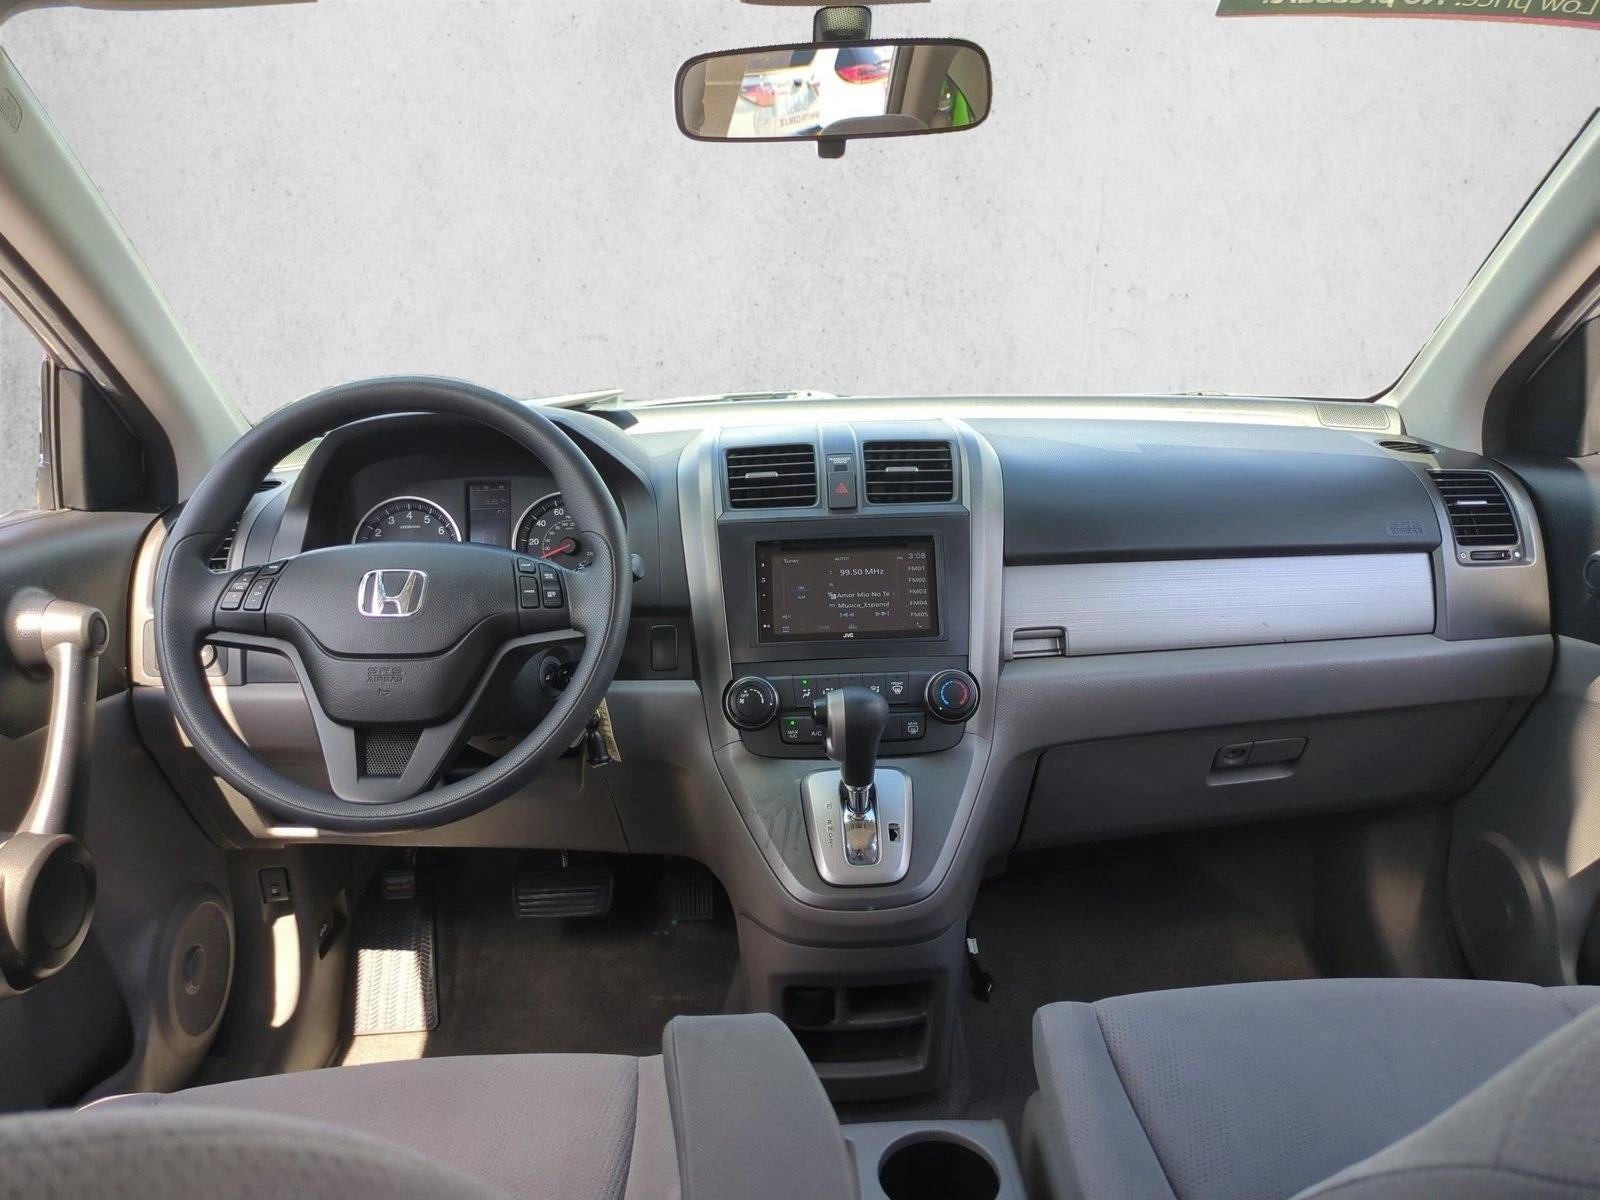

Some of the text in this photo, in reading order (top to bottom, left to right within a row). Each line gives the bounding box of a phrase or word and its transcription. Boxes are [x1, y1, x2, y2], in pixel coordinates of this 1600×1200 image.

[406, 511, 413, 520] 4
[553, 508, 564, 516] 60
[388, 516, 395, 525] 3
[424, 515, 431, 524] 5
[536, 519, 547, 527] 40
[374, 528, 382, 537] 2
[438, 526, 445, 535] 6
[528, 538, 539, 546] 20
[865, 568, 885, 576] MHz
